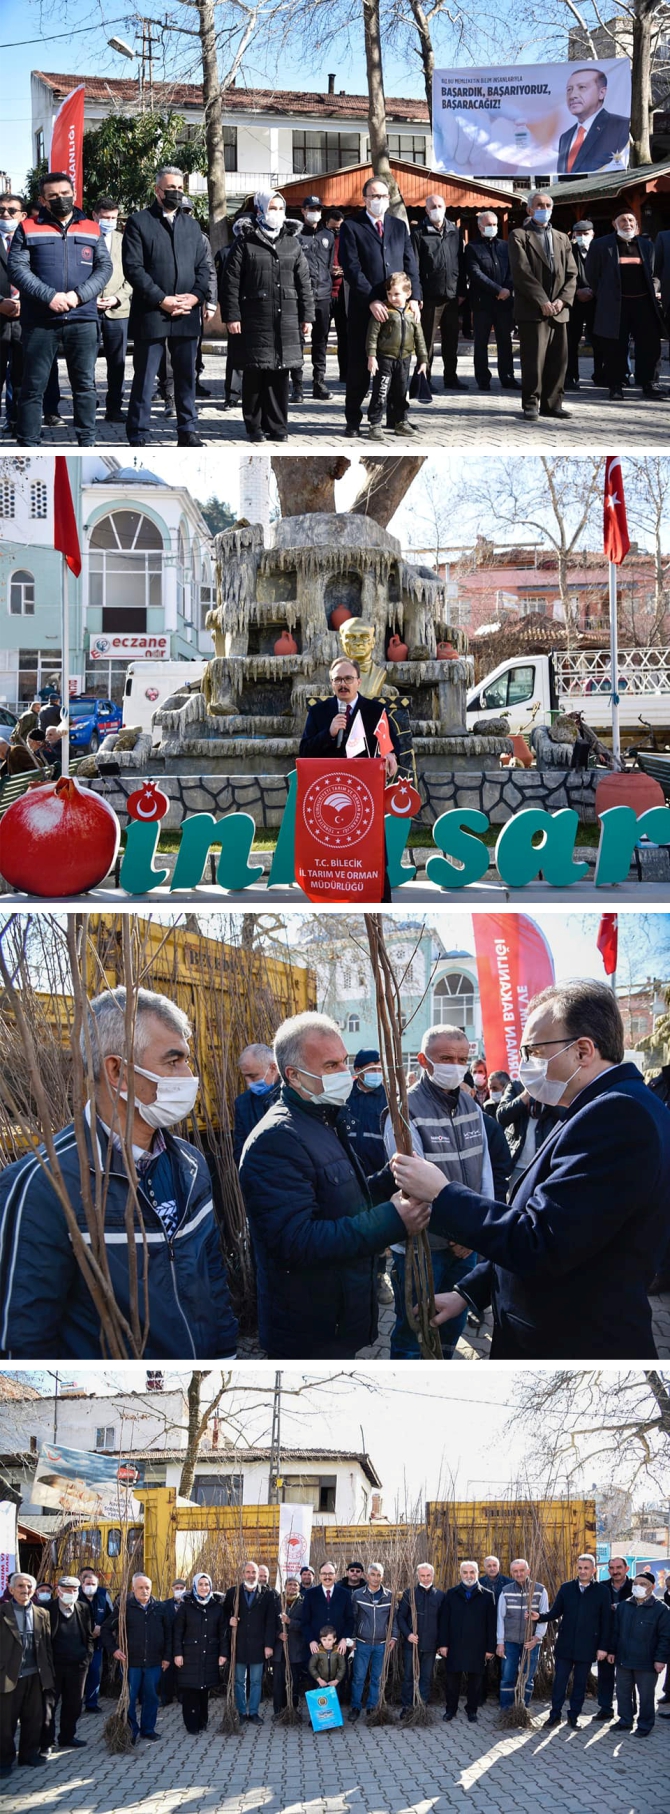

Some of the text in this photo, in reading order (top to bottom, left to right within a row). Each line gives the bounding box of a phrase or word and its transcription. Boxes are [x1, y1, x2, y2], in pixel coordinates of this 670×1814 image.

[441, 84, 551, 98] BAŞARDIK, BAŞARIYORUZ,
[442, 98, 501, 110] BAŞARACAĞIZ!
[68, 125, 76, 196] KANLIĞI
[112, 637, 167, 648] eczane
[314, 858, 363, 868] T.C. BİLECİK
[299, 868, 379, 880] İL TARIM VE ORMAN
[310, 880, 364, 891] MÜDÜRLÜĞÜ
